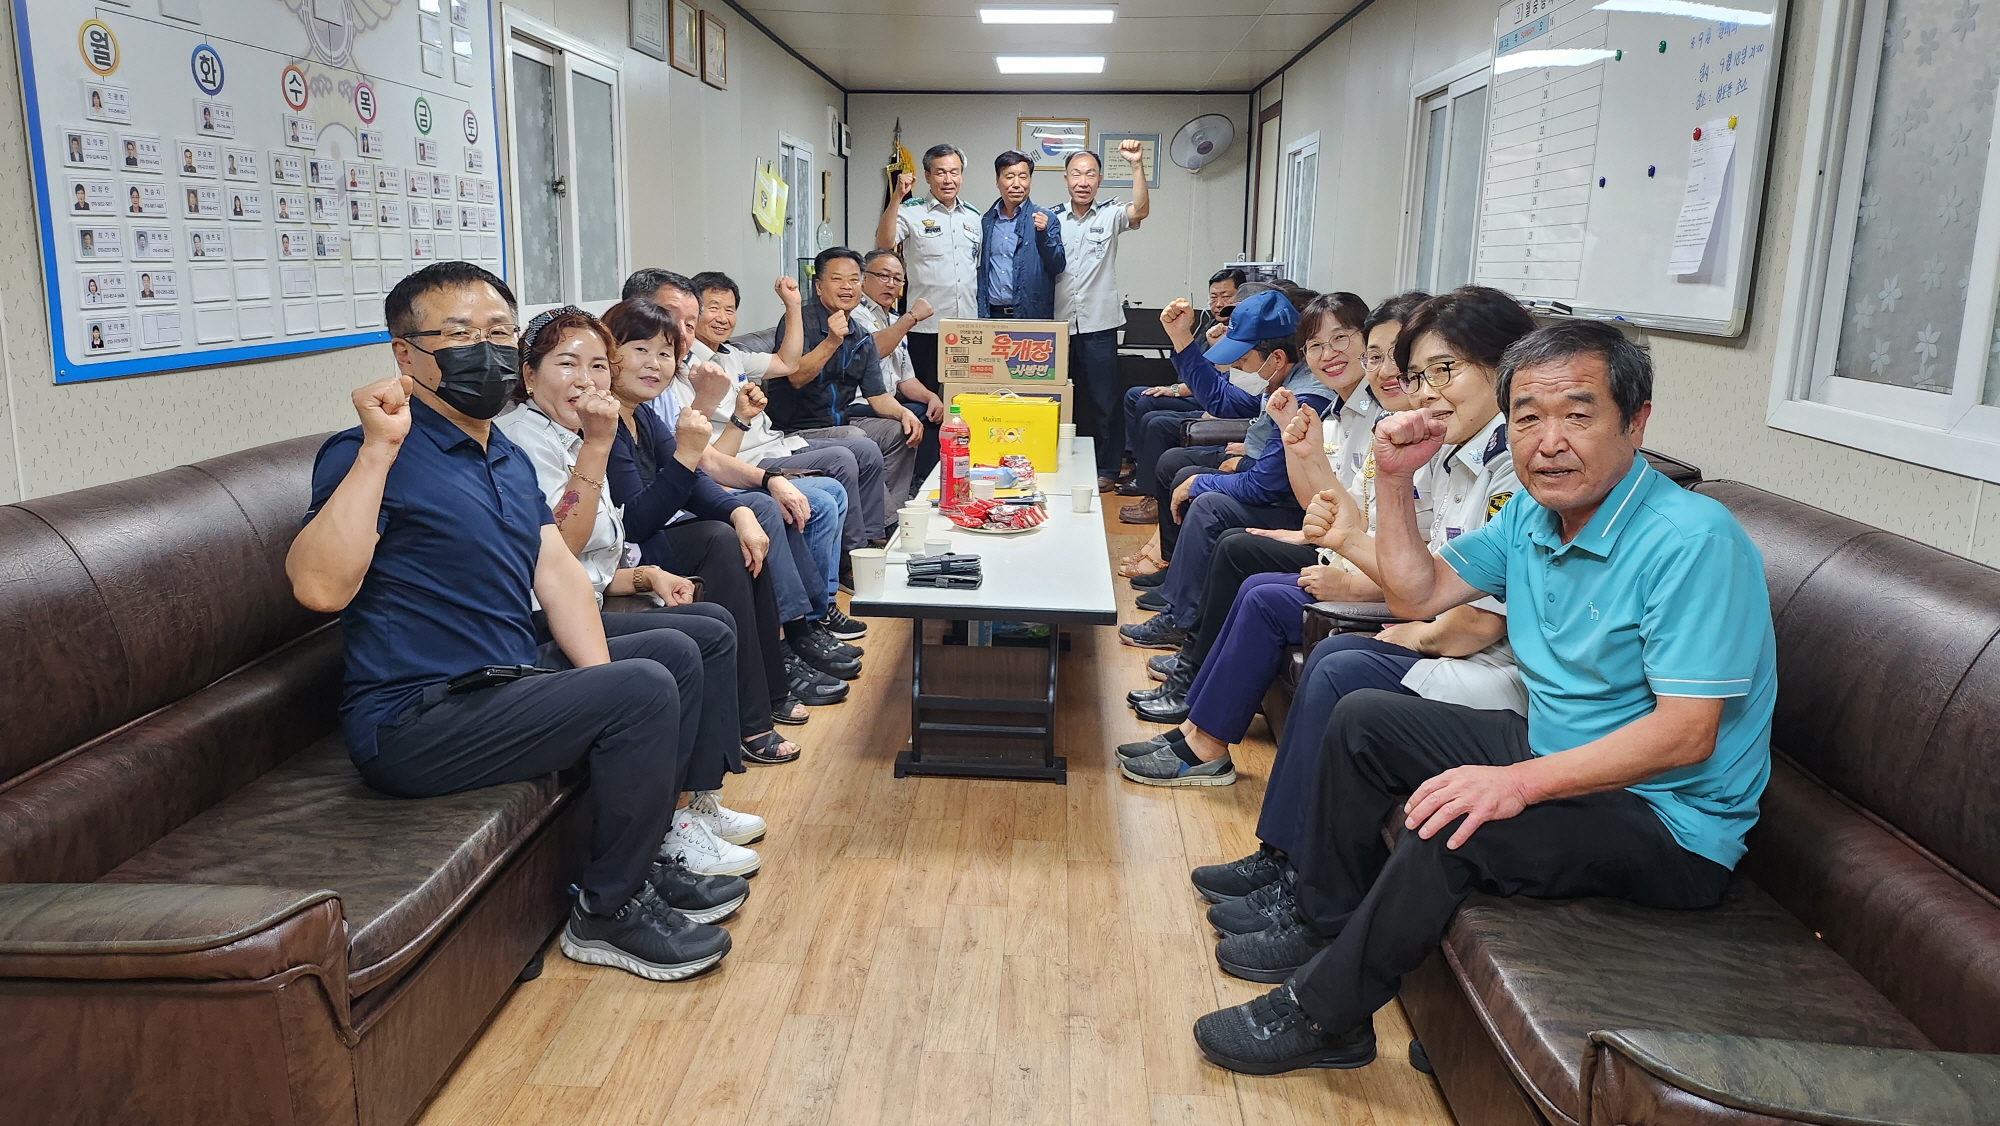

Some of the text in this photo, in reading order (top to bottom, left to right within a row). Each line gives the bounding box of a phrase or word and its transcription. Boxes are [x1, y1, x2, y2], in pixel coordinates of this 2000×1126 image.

[90, 29, 111, 67] 월
[199, 54, 216, 87] 화
[289, 74, 303, 103] 수
[360, 90, 371, 117] 목
[418, 104, 428, 129] 금
[467, 116, 476, 137] 토
[959, 335, 983, 345] 농심
[990, 334, 1053, 363] 육개장
[1010, 364, 1050, 377] 사발면
[982, 415, 1002, 423] Maxim
